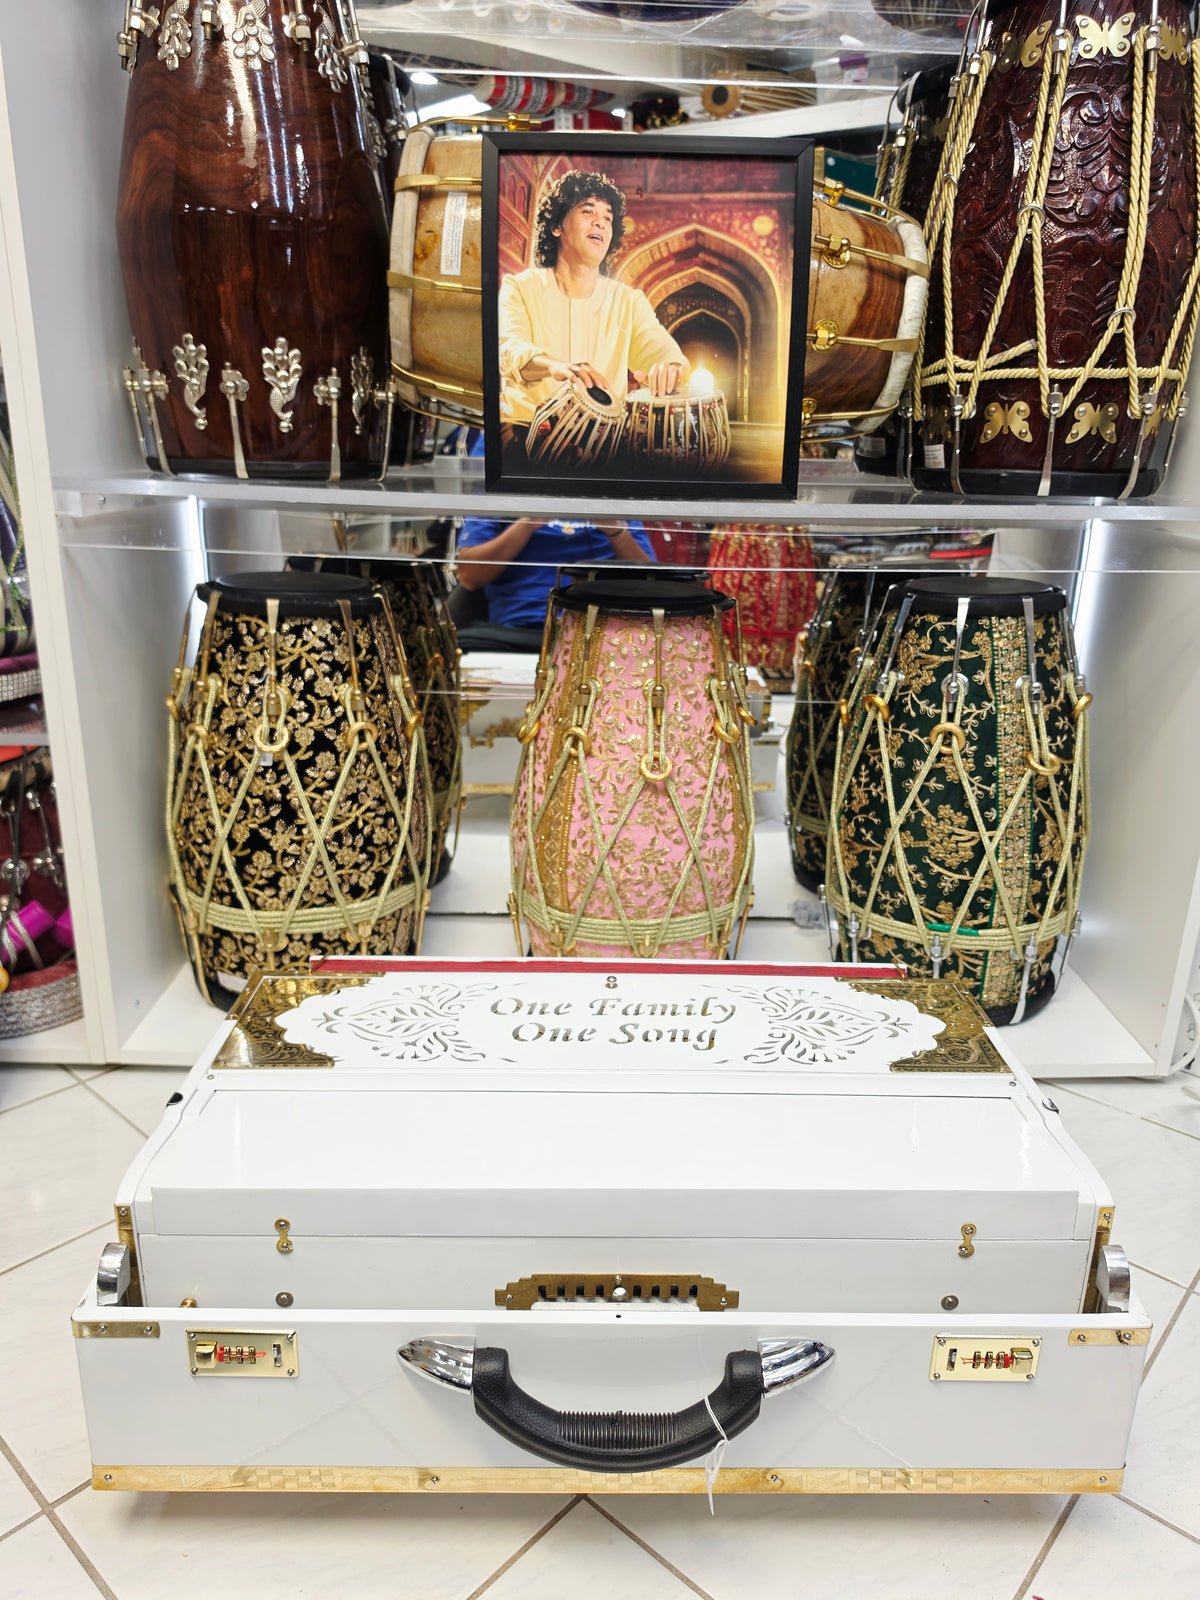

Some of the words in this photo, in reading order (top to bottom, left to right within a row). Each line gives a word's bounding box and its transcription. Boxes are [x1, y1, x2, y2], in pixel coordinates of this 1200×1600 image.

[490, 997, 573, 1016] One
[589, 996, 737, 1024] Family
[511, 1022, 597, 1042] One
[608, 1022, 718, 1051] Song
